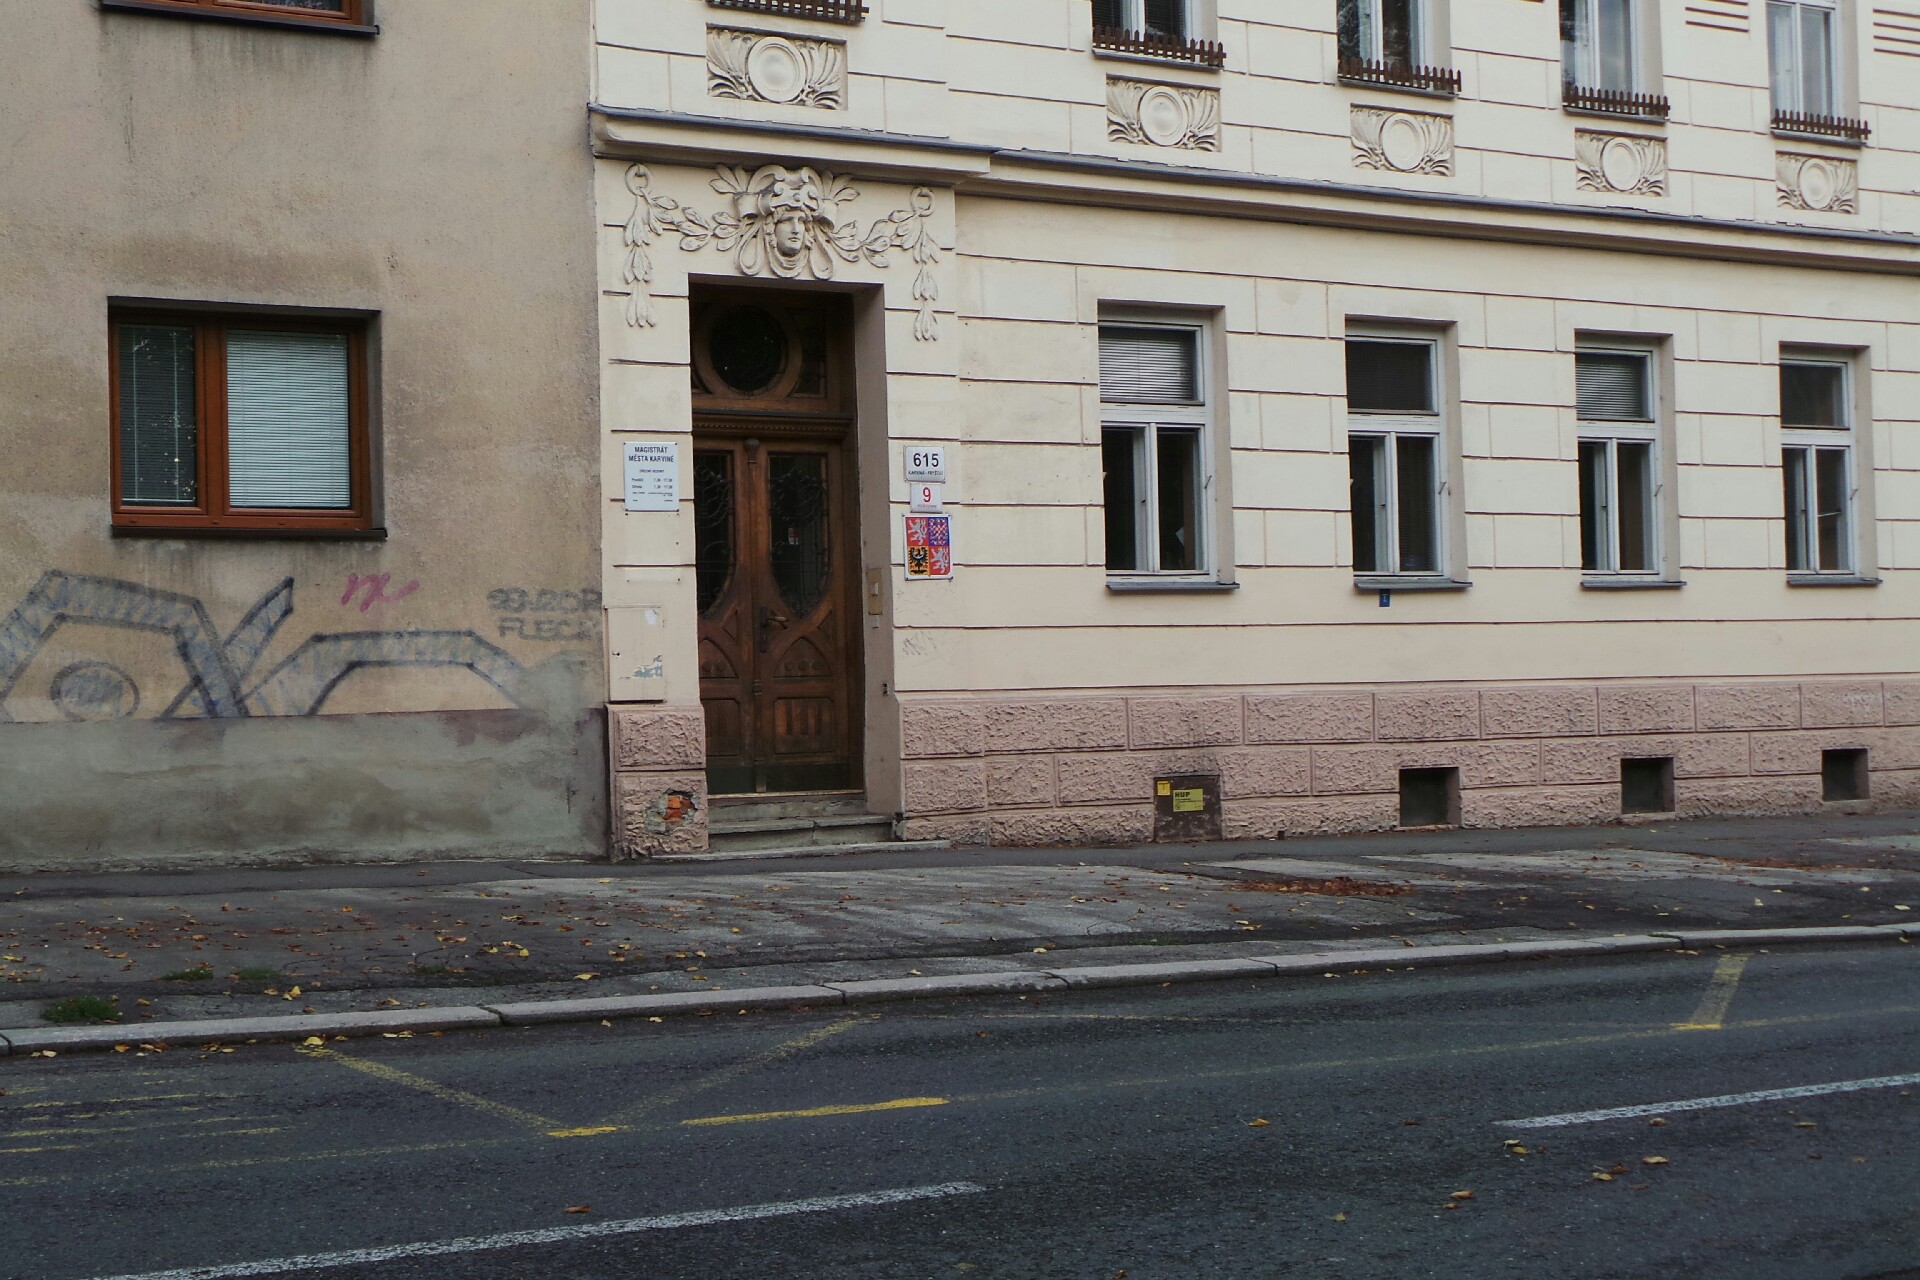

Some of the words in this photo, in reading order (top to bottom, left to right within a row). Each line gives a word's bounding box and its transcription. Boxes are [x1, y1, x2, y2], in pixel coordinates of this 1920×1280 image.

[628, 454, 649, 462] MĚSTA
[913, 452, 939, 467] 615
[922, 486, 932, 503] 9
